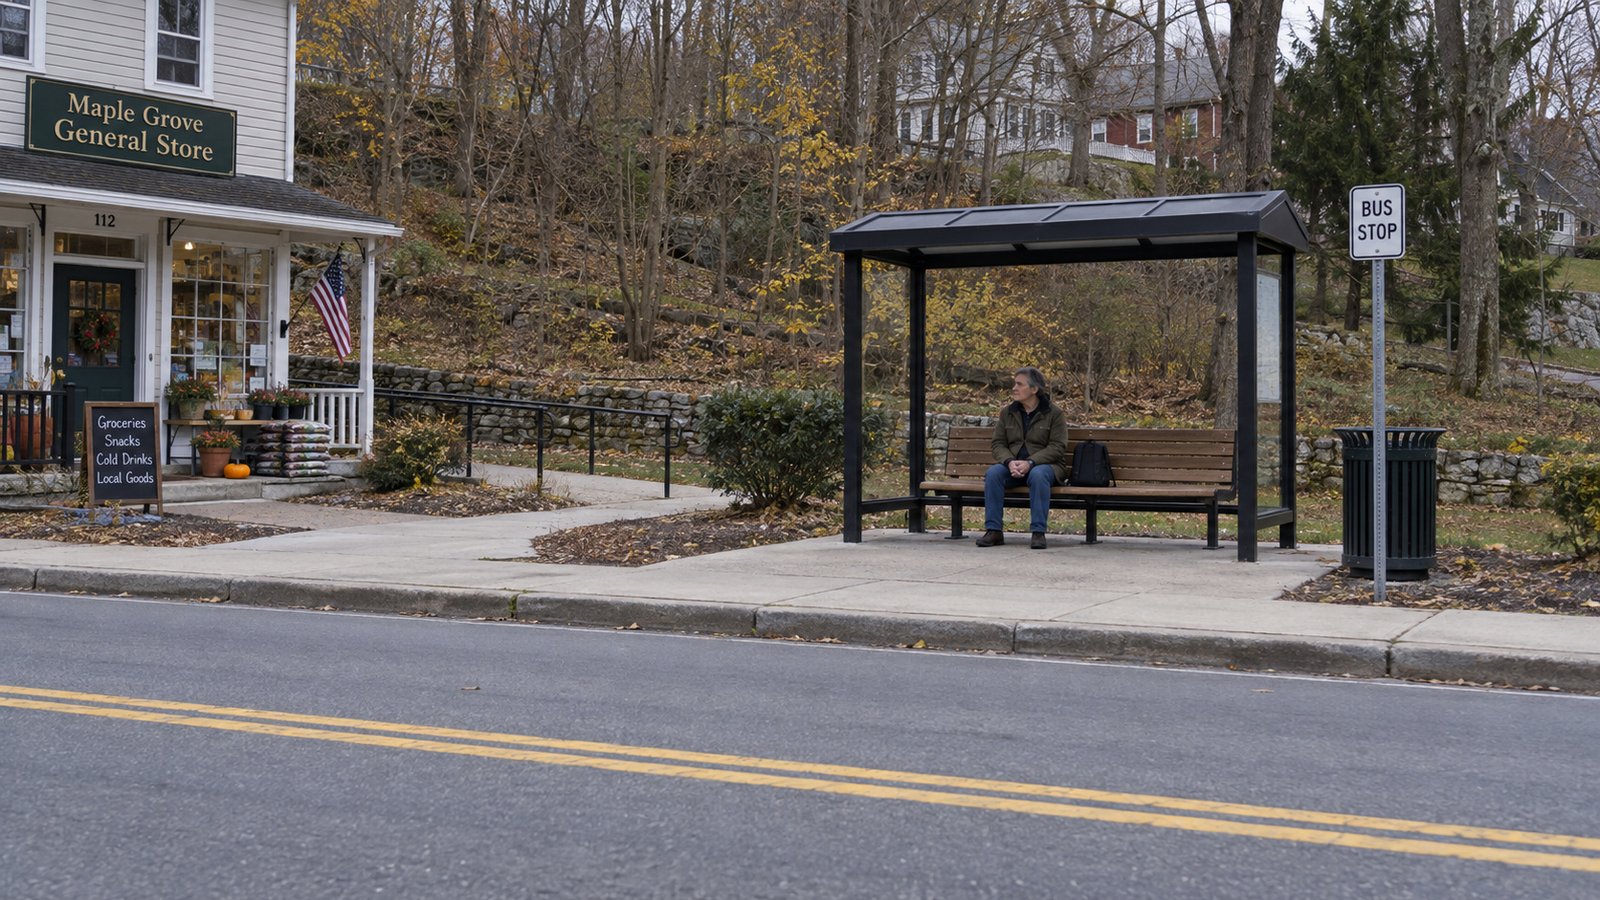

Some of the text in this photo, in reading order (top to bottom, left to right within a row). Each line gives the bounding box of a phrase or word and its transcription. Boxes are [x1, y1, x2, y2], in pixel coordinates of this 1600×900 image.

[67, 92, 204, 133] Maple Grove
[54, 118, 213, 161] General Store
[1362, 199, 1392, 217] BUS
[94, 213, 115, 227] 112
[1358, 223, 1397, 240] STOP
[97, 415, 146, 429] Groceries
[104, 434, 141, 447] Snacks
[96, 452, 153, 465] Cold Drinks
[97, 471, 154, 484] Local Goods
